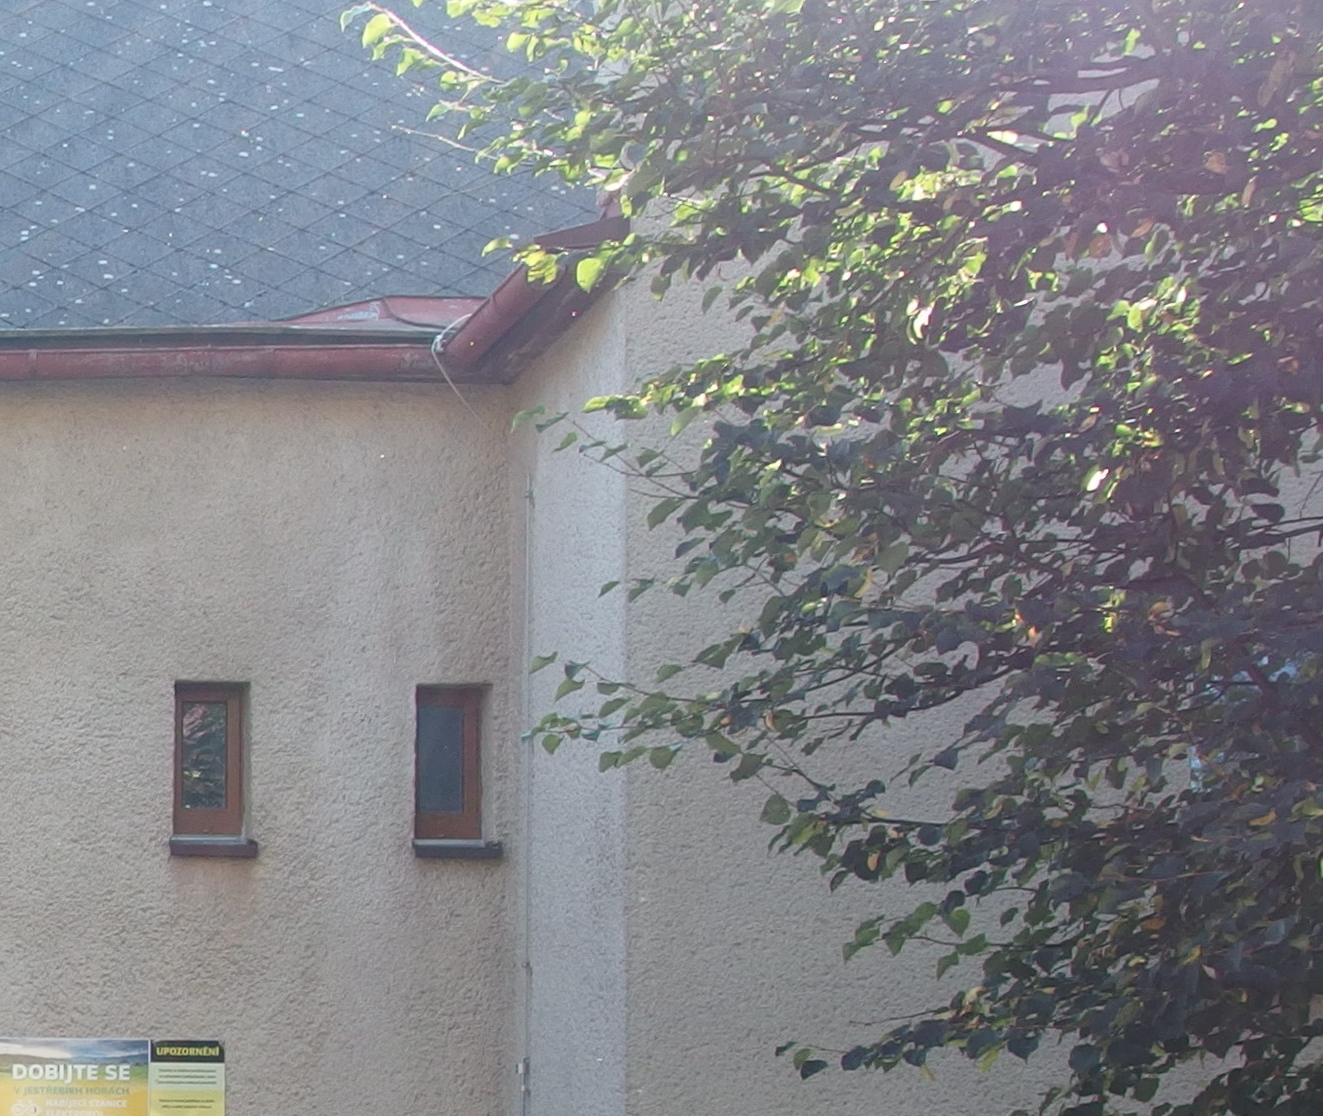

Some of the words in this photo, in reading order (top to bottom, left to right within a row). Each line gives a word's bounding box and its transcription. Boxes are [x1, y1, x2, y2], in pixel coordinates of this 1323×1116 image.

[156, 1046, 219, 1057] UPOZORNĚNÍ
[12, 1064, 99, 1084] DOBIJTE
[105, 1064, 131, 1081] SE
[89, 1099, 128, 1108] STANICE
